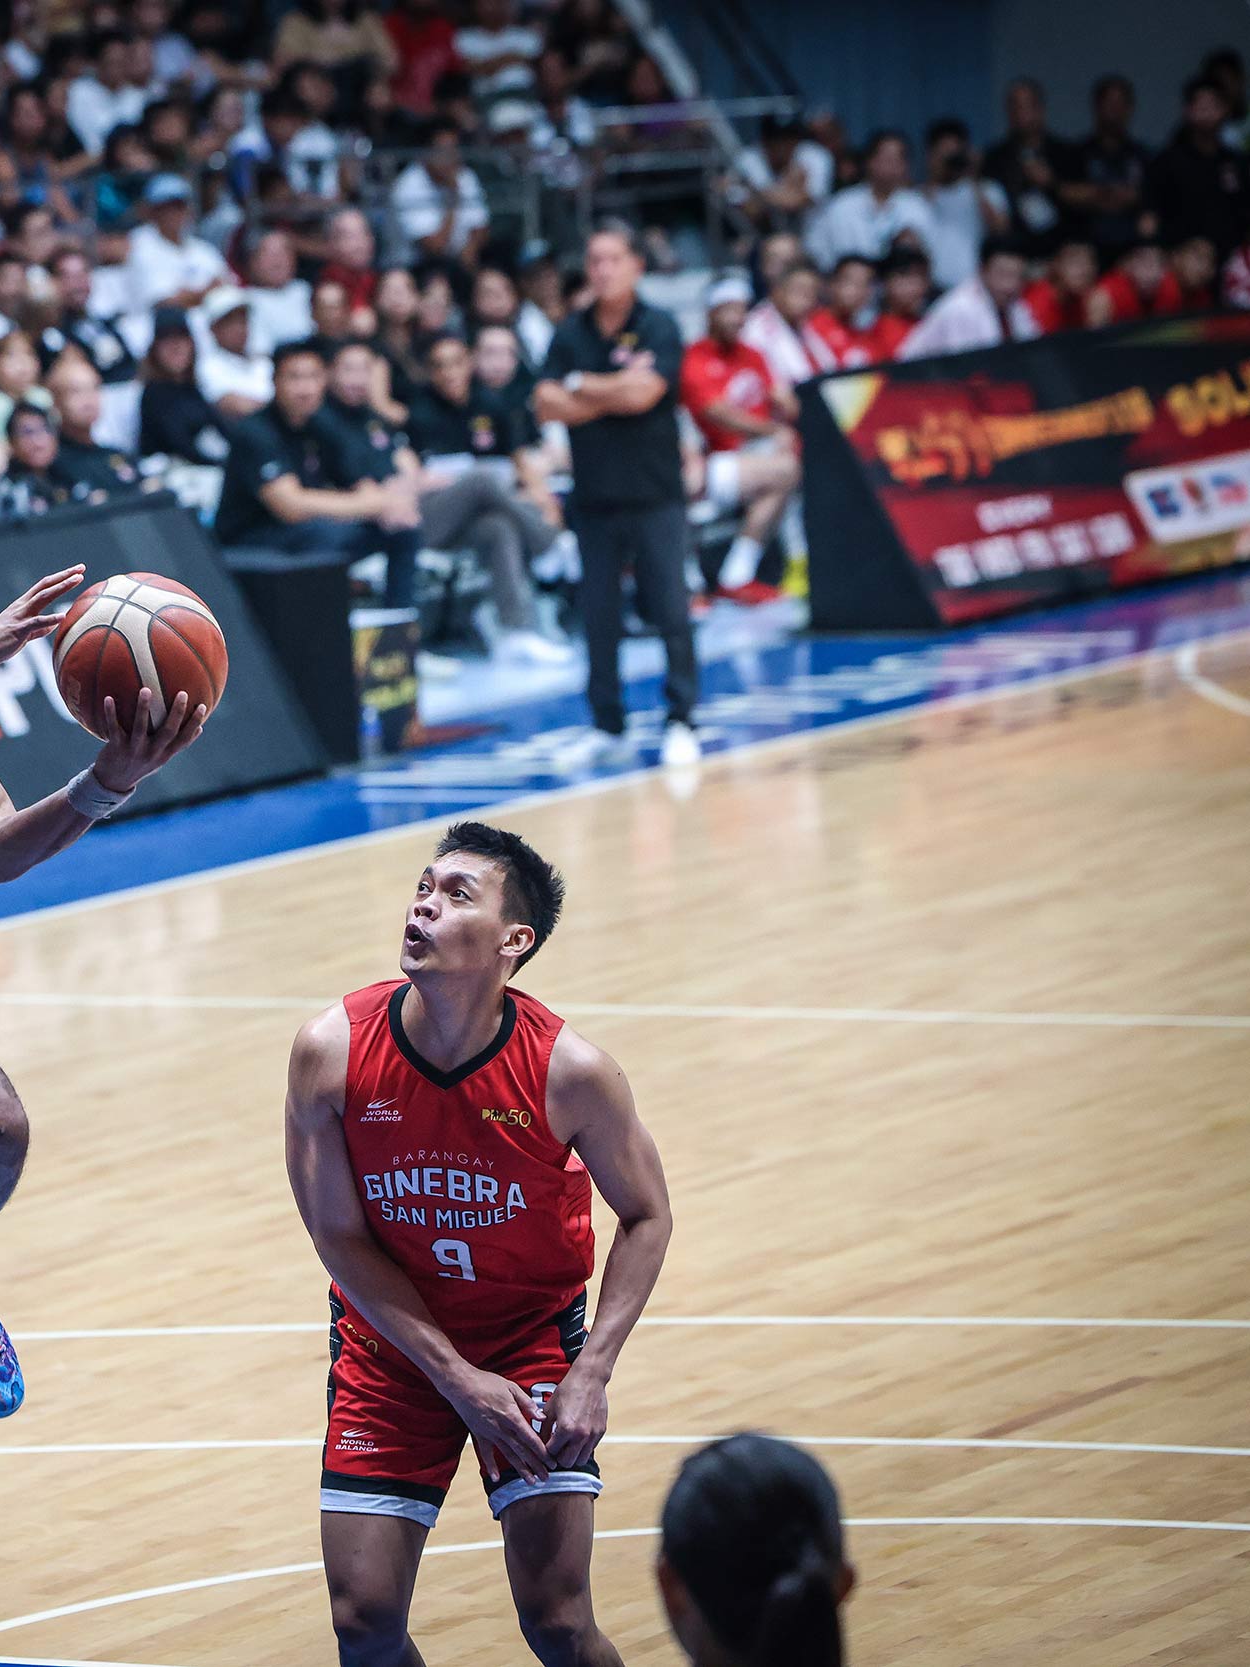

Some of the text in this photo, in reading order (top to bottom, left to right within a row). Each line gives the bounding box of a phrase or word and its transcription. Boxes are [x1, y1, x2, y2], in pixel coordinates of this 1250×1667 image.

[392, 1150, 494, 1170] BARANGAY
[363, 1167, 527, 1210] GINEBRA
[381, 1200, 517, 1229] SAN MIGUEL
[431, 1238, 477, 1282] 9
[335, 1444, 379, 1452] BALANCE
